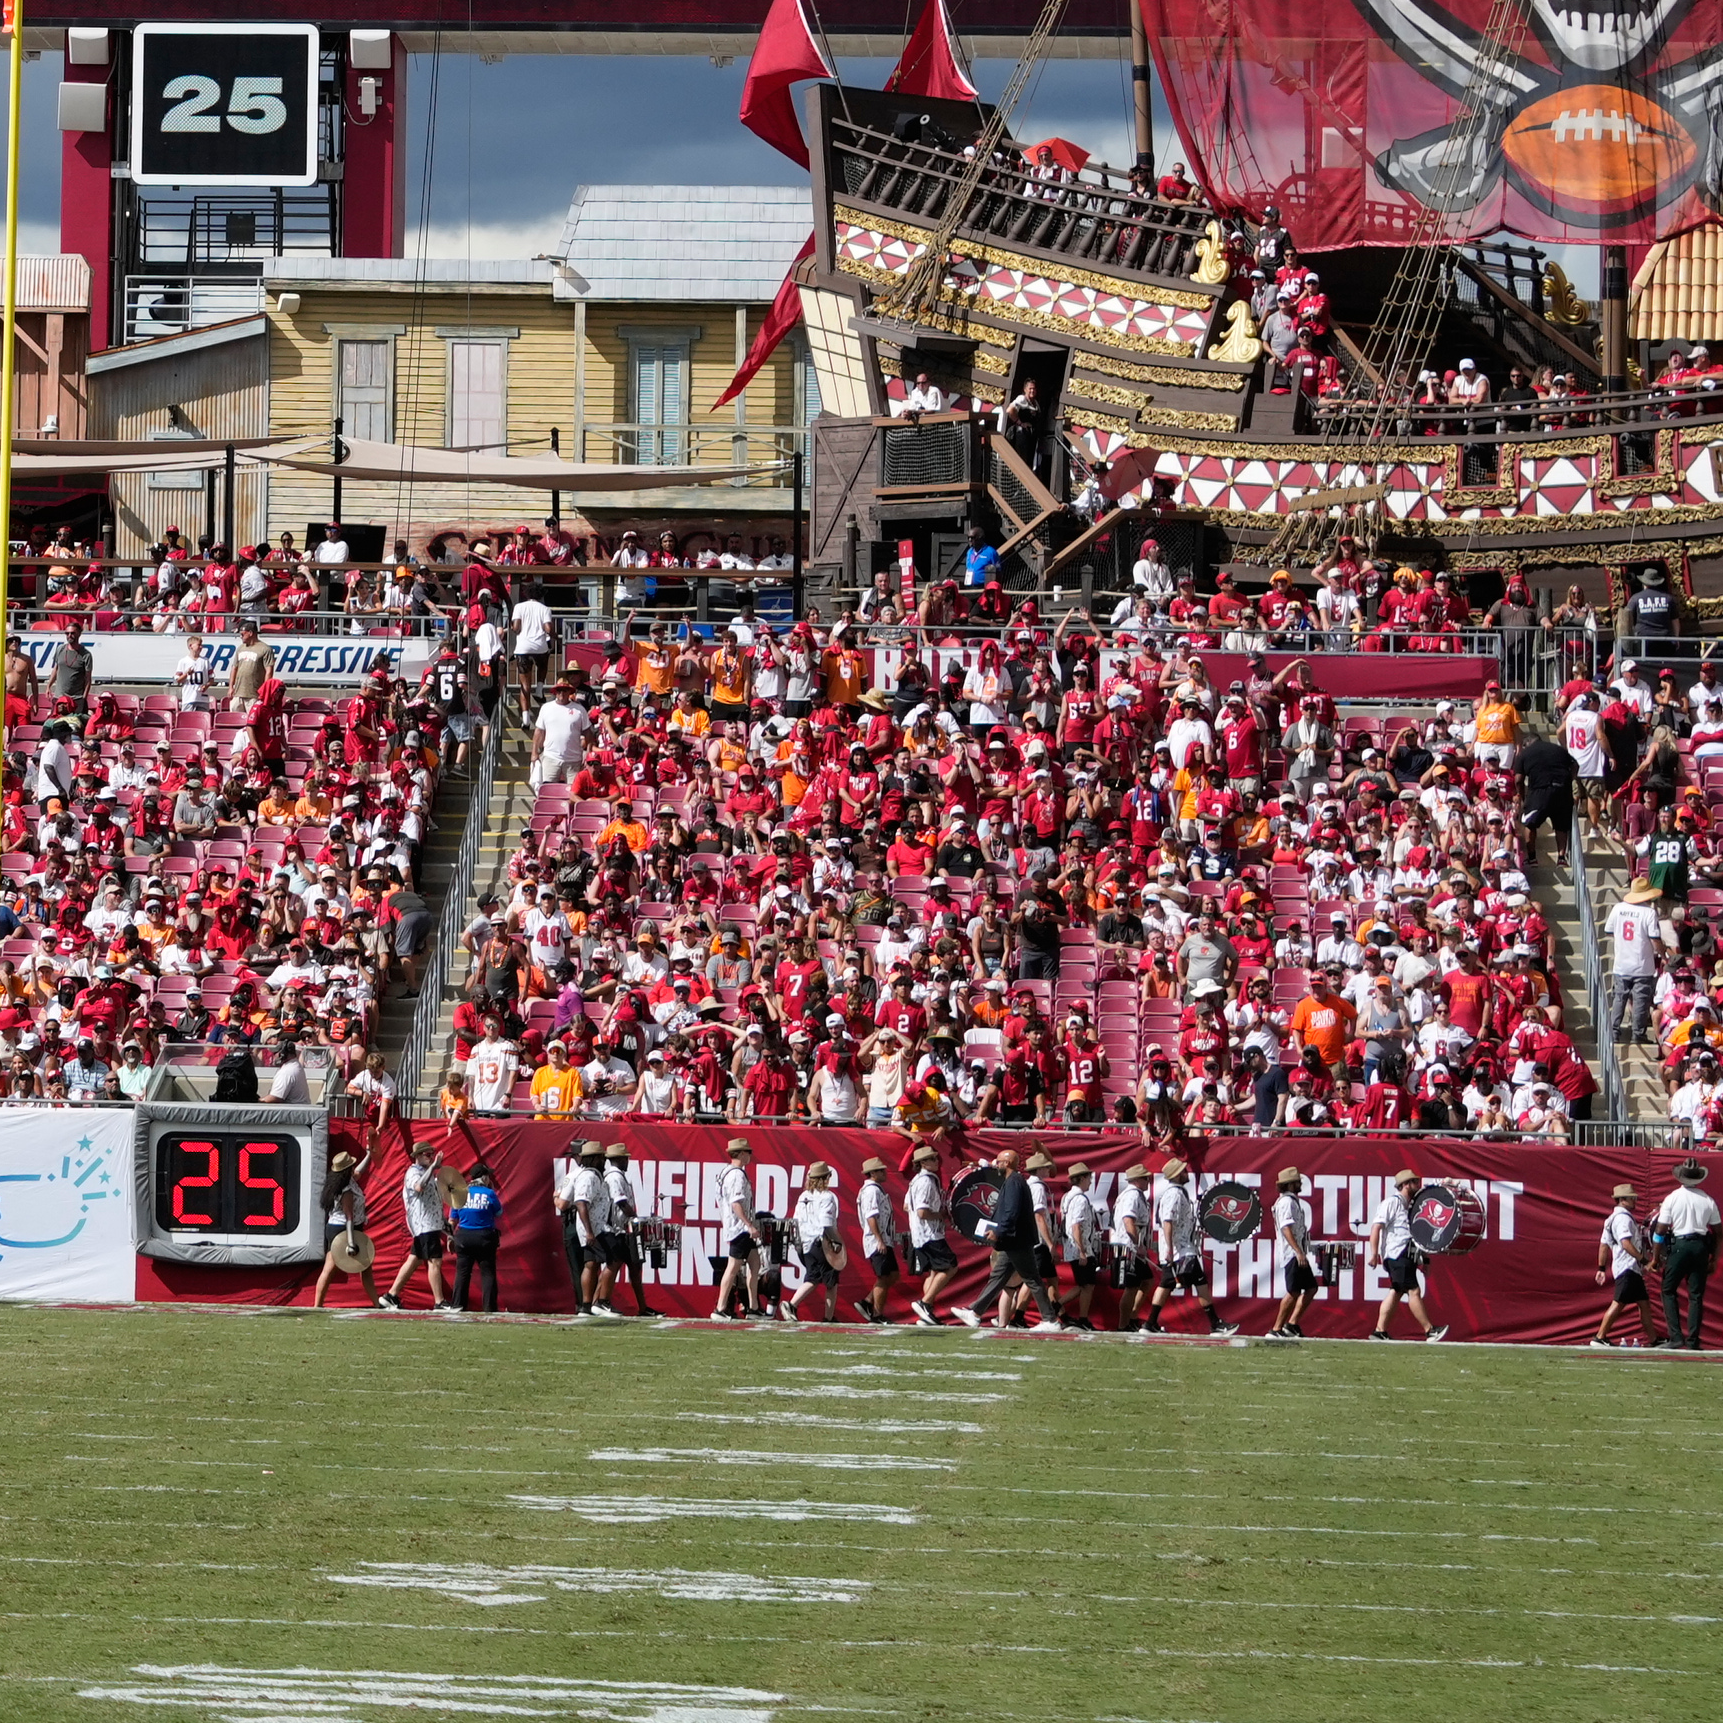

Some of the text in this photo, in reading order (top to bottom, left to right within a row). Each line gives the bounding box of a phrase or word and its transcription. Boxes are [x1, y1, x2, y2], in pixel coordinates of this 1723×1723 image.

[161, 75, 287, 135] 25
[441, 676, 452, 698] 6
[1068, 702, 1089, 719] 67
[268, 716, 281, 736] 12
[1228, 734, 1237, 750] 6
[633, 763, 644, 781] 2
[1136, 799, 1152, 820] 12
[1655, 841, 1679, 862] 28
[1622, 920, 1634, 941] 6
[789, 975, 803, 996] 7
[897, 1014, 910, 1033] 2
[478, 1064, 499, 1083] 13
[1069, 1061, 1092, 1084] 12
[1384, 1100, 1396, 1119] 7
[171, 1141, 284, 1227] 25
